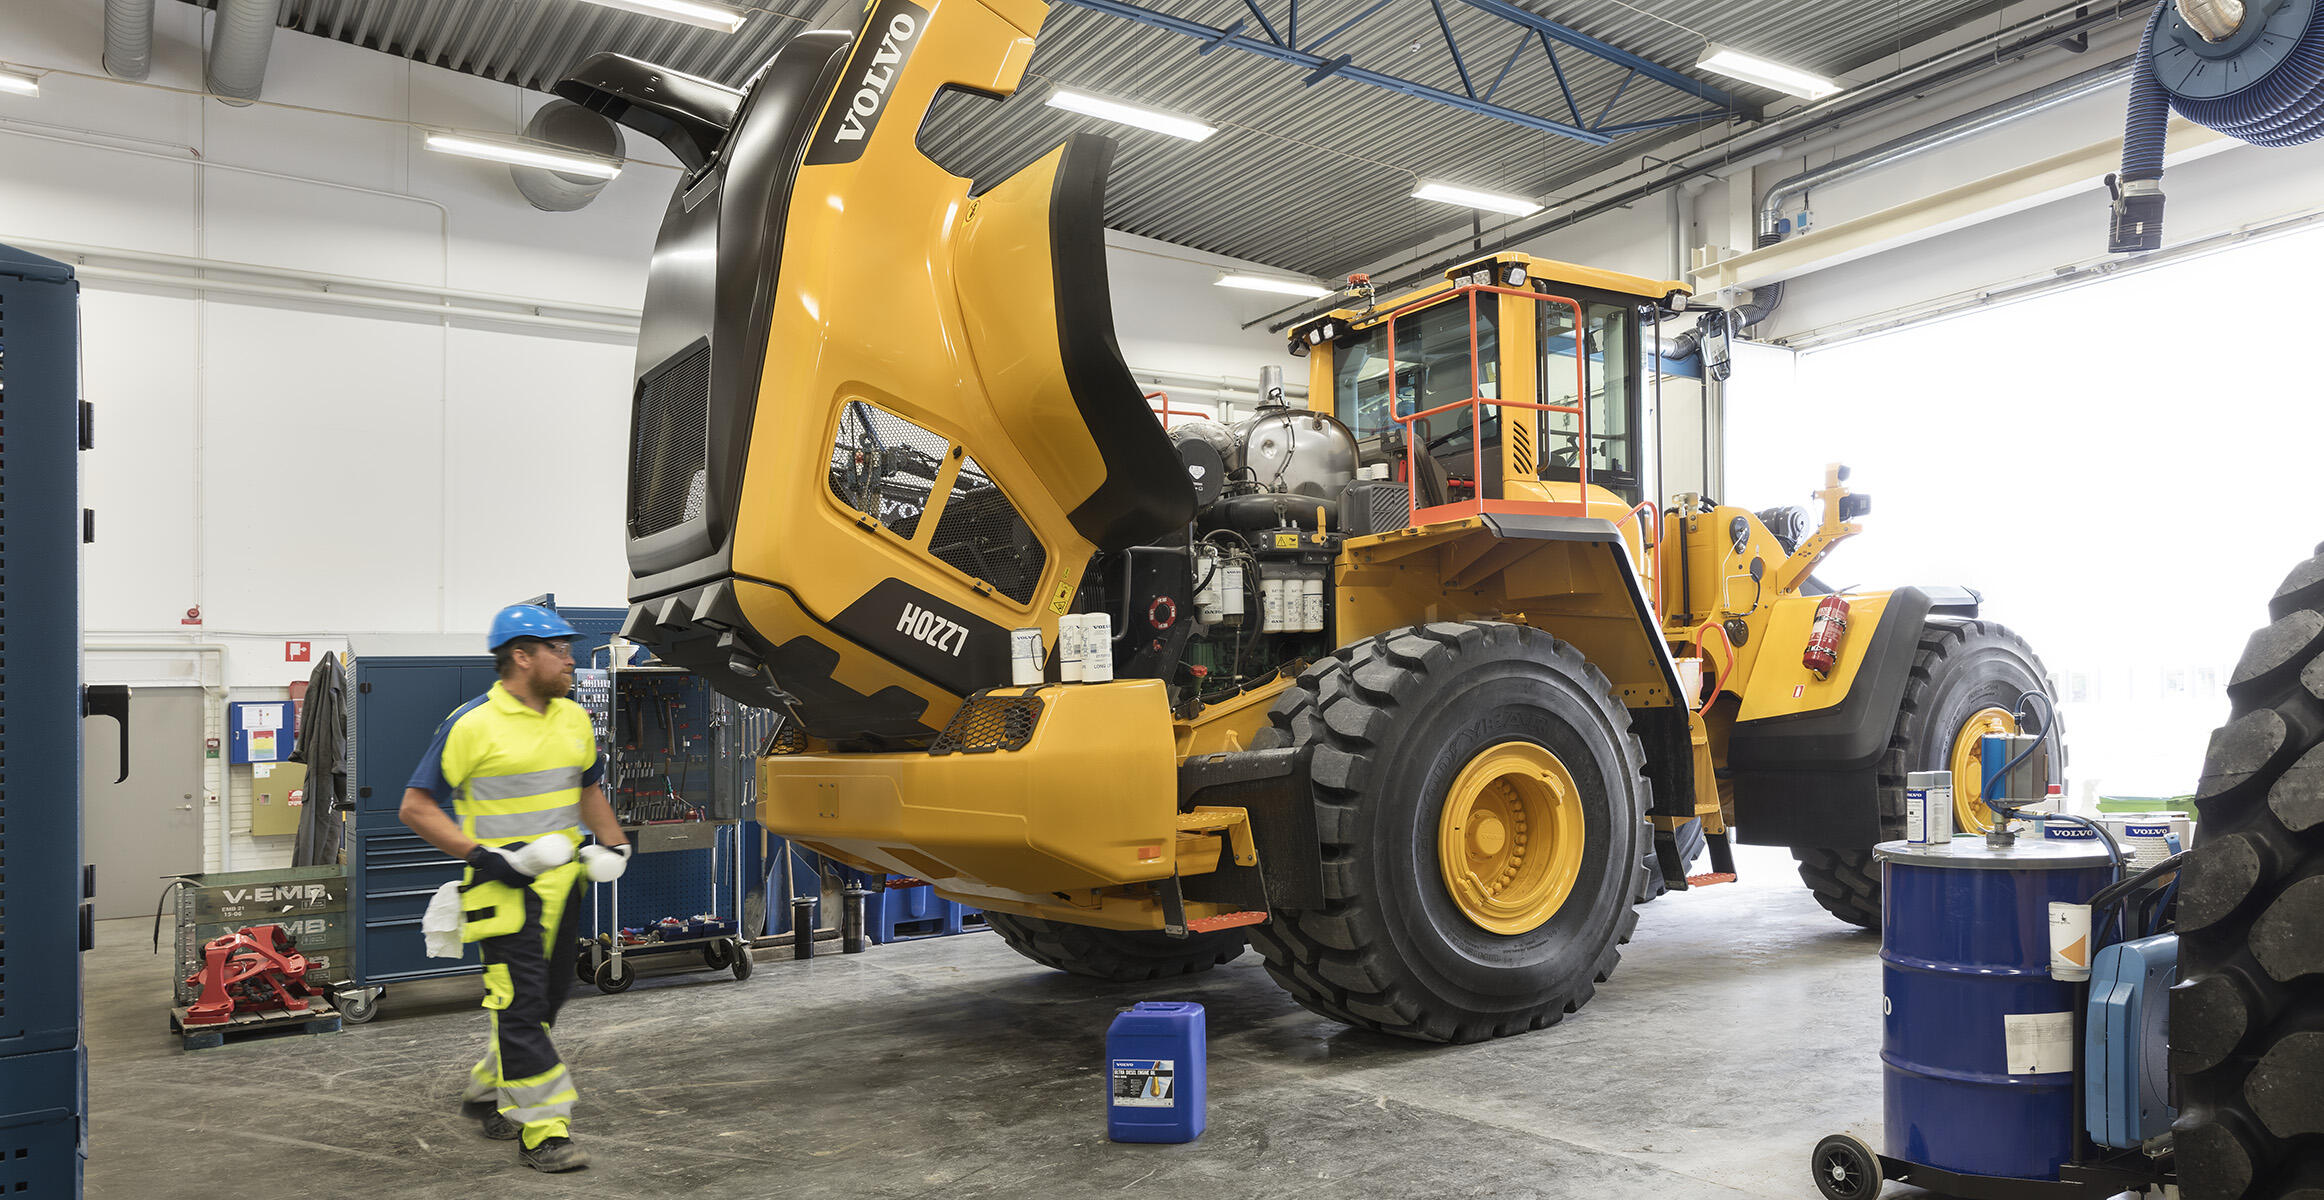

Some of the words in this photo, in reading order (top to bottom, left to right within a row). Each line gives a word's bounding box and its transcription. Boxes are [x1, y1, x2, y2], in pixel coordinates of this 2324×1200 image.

[834, 13, 915, 143] VOLVO
[896, 602, 969, 657] L220H
[2052, 829, 2093, 837] VOLVO
[222, 884, 326, 904] V-EMB
